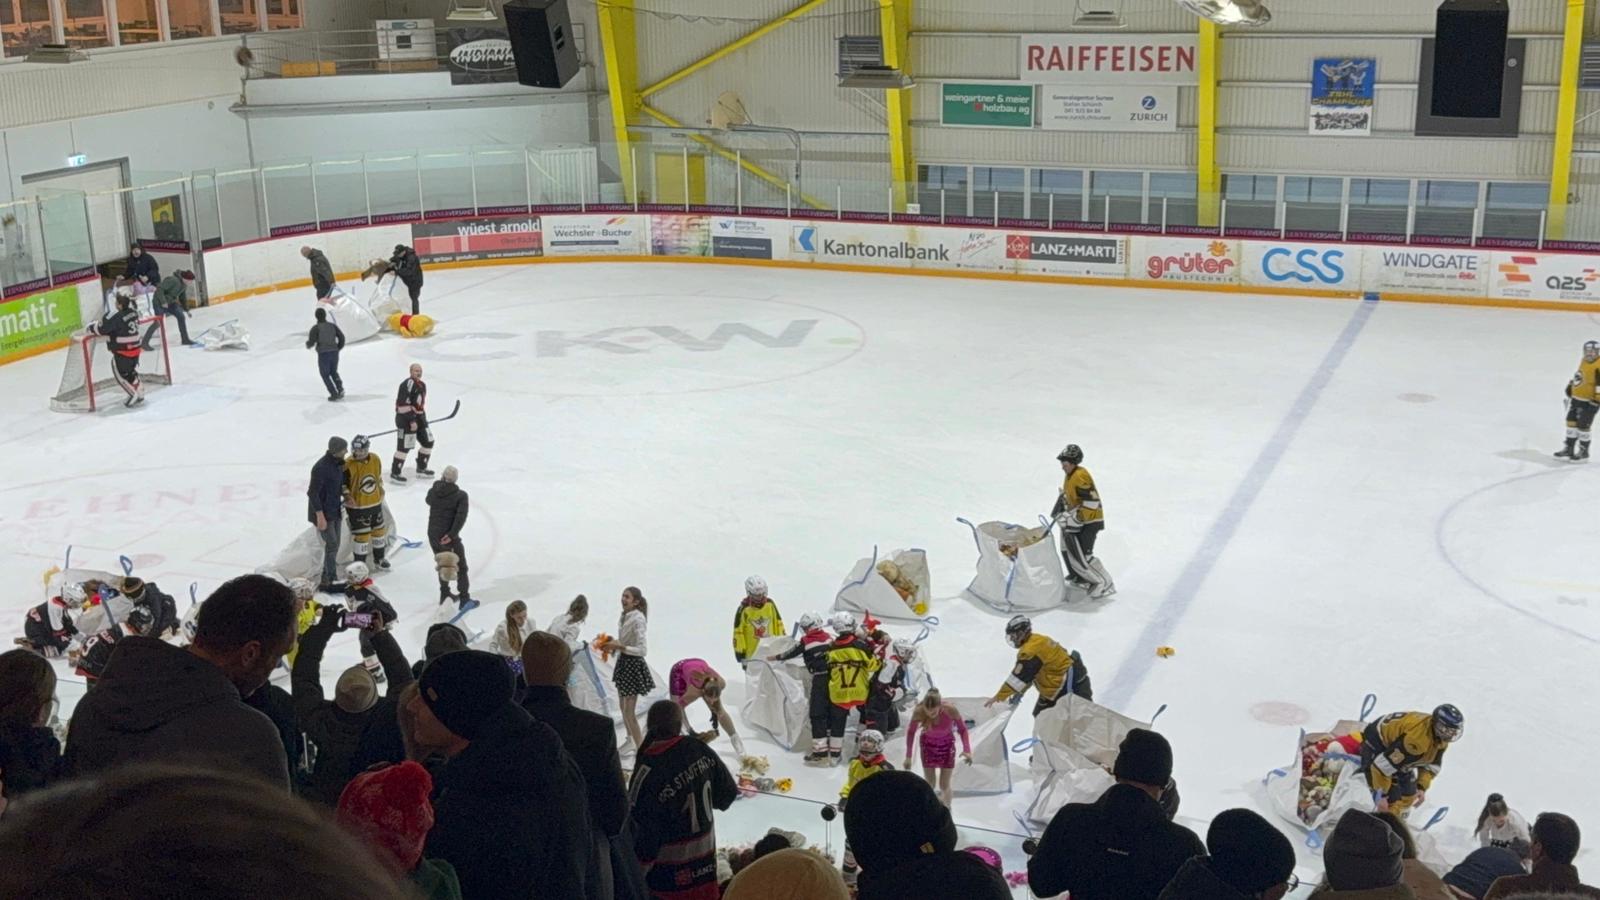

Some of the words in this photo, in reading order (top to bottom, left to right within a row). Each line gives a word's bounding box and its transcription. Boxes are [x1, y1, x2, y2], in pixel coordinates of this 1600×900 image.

[1027, 45, 1195, 72] RAIFFEISEN
[944, 94, 996, 104] weingartner
[1005, 94, 1031, 104] meier
[982, 103, 1007, 114] holzbau
[1010, 105, 1030, 116] ag
[1130, 113, 1168, 122] ZURICH
[457, 222, 497, 236] wüest
[500, 219, 541, 233] arnold
[554, 229, 595, 238] Wechsler
[601, 228, 633, 237] Bucher
[823, 239, 950, 262] Kantonalbank
[1030, 241, 1116, 259] LANZ+MARTI
[1147, 251, 1235, 279] grüter
[1262, 247, 1345, 284] CSS
[1383, 250, 1478, 271] WINDGATE
[1162, 274, 1233, 283] HAUSTECHNIK
[1545, 275, 1587, 291] a2s
[403, 319, 821, 362] CKW
[0, 480, 309, 521] EHNER
[838, 665, 862, 689] 17
